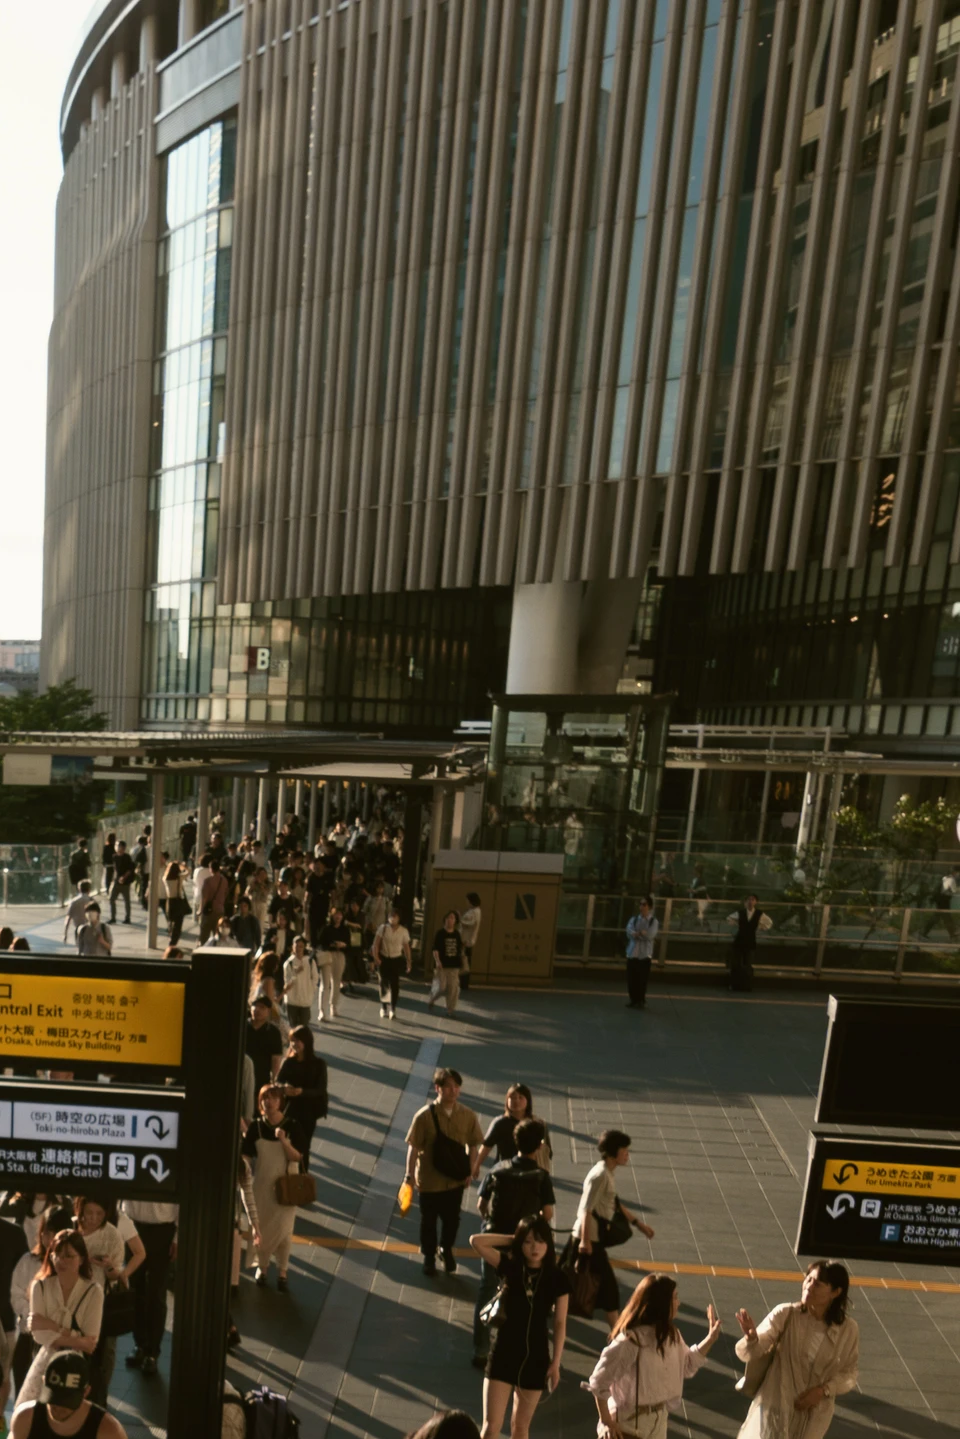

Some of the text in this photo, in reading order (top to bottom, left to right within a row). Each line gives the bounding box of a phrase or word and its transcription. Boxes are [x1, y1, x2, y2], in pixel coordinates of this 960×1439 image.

[37, 1004, 63, 1018] Exit
[71, 1009, 127, 1021] 中央北出口
[35, 1037, 66, 1048] Umeda
[68, 1040, 83, 1051] Sky
[85, 1041, 122, 1053] Building
[55, 1111, 126, 1127] 時空の広場
[35, 1123, 126, 1138] Toki-no-hiroba Plaza
[6, 1161, 27, 1173] Sta.
[29, 1163, 70, 1178] (Bridge
[72, 1166, 103, 1178] Gate)
[866, 1167, 934, 1181] うめきた公園
[866, 1178, 932, 1189] for Umekita Park
[926, 1203, 960, 1215] うめき
[885, 1225, 895, 1239] F
